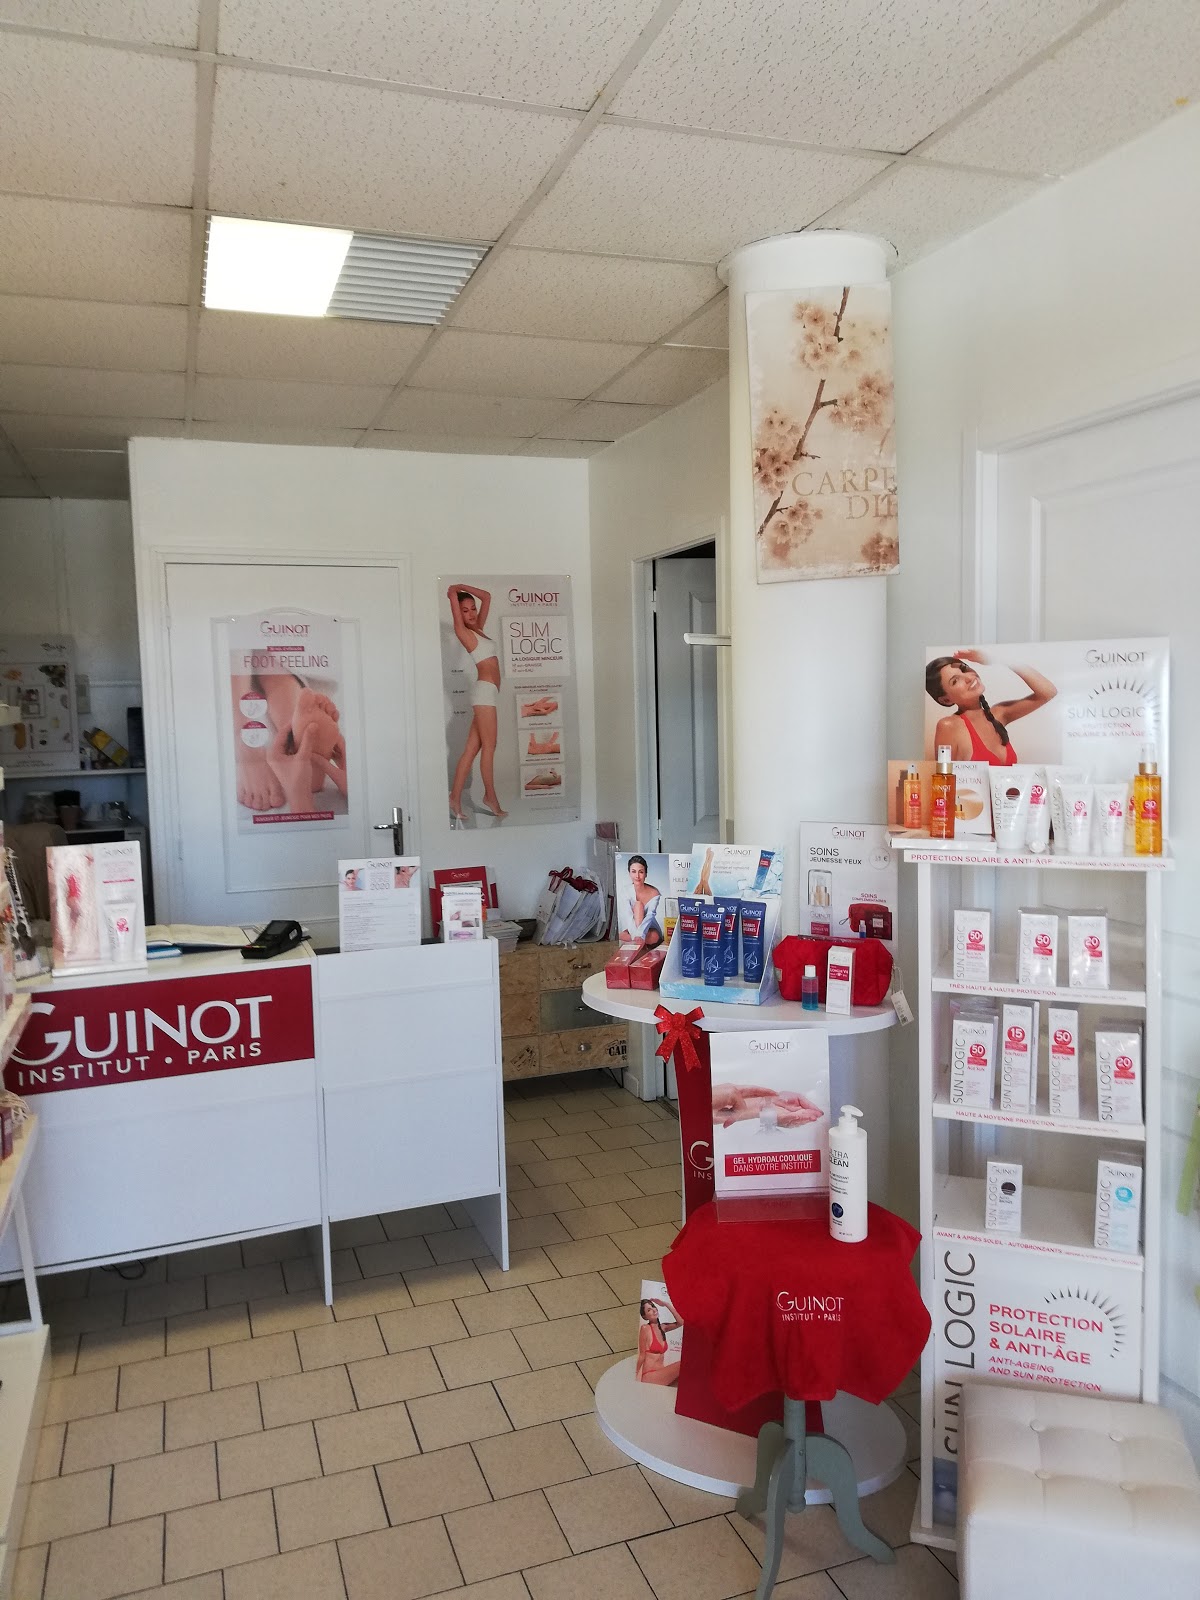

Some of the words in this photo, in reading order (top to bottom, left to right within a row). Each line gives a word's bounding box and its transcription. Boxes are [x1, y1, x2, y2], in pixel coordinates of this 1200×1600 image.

[792, 467, 896, 497] CARPE
[508, 588, 560, 603] GUINOT
[260, 620, 310, 635] GUINOT
[509, 621, 550, 638] SLIM
[510, 637, 563, 655] LOGIC
[243, 655, 277, 669] FOOT
[279, 654, 330, 668] PEELING
[1085, 649, 1147, 664] GUINOT
[1101, 706, 1146, 718] LOGIC
[1031, 785, 1043, 794] 20
[935, 798, 945, 806] 15
[1144, 800, 1156, 809] 50
[831, 826, 867, 838] GUINOT
[723, 847, 752, 857] GUINOT
[809, 846, 840, 857] SOINS
[911, 853, 963, 862] PROTECTION
[965, 856, 1002, 864] SOLAIRE
[700, 910, 723, 919] GUINOT
[741, 907, 763, 916] GUINOT
[957, 926, 965, 956] LOGIC
[1037, 935, 1050, 944] 50
[1085, 936, 1099, 946] 20
[956, 958, 965, 978] SUN
[965, 984, 987, 992] HAUTE
[9, 995, 273, 1066] GUINOT
[1010, 1027, 1023, 1038] 15
[1055, 1031, 1070, 1041] 50
[748, 1039, 791, 1051] GUINOT
[971, 1045, 985, 1054] 50
[18, 1055, 150, 1087] INSTITUT
[187, 1042, 262, 1065] PARIS
[954, 1038, 966, 1076] LOGIC
[1117, 1057, 1131, 1066] 20
[1003, 1056, 1013, 1087] LOGIC
[1052, 1061, 1061, 1092] LOGIC
[1099, 1051, 1112, 1091] LOGIC
[953, 1080, 964, 1104] SUN
[1003, 1089, 1012, 1109] SUN
[1052, 1094, 1061, 1114] SUN
[1101, 1095, 1113, 1121] SUN
[955, 1110, 976, 1118] HAUTE
[983, 1114, 1014, 1123] MOYENNE
[1015, 1118, 1055, 1127] PROTECTION
[733, 1156, 746, 1165] GEL
[748, 1153, 813, 1164] HYDROALCOOLIQUE
[733, 1163, 754, 1173] DANS
[755, 1162, 779, 1172] VOTRE
[781, 1161, 813, 1170] INSTITUT
[988, 1176, 998, 1206] LOGIC
[1099, 1179, 1112, 1219] LOGIC
[988, 1209, 997, 1226] SUN
[936, 1230, 956, 1239] AVANT
[962, 1233, 982, 1242] APRÈS
[983, 1237, 1004, 1246] SOLEIL
[1008, 1241, 1063, 1254] AUTOBRONZANTS
[1097, 1221, 1109, 1246] SUN
[776, 1291, 845, 1312] GUINOT
[943, 1249, 976, 1370] LOGIC
[782, 1312, 814, 1322] INSTITUT
[823, 1313, 841, 1322] PARIS
[989, 1303, 1104, 1333] PROTECTION
[989, 1320, 1067, 1344] SOLAIRE
[989, 1337, 1001, 1349] &
[1005, 1340, 1092, 1365] ANTI-ÂGE
[988, 1355, 1055, 1373] ANTI-AGEING
[988, 1366, 1011, 1375] AND
[1013, 1370, 1034, 1380] SUN
[1036, 1374, 1102, 1392] PROTECTION
